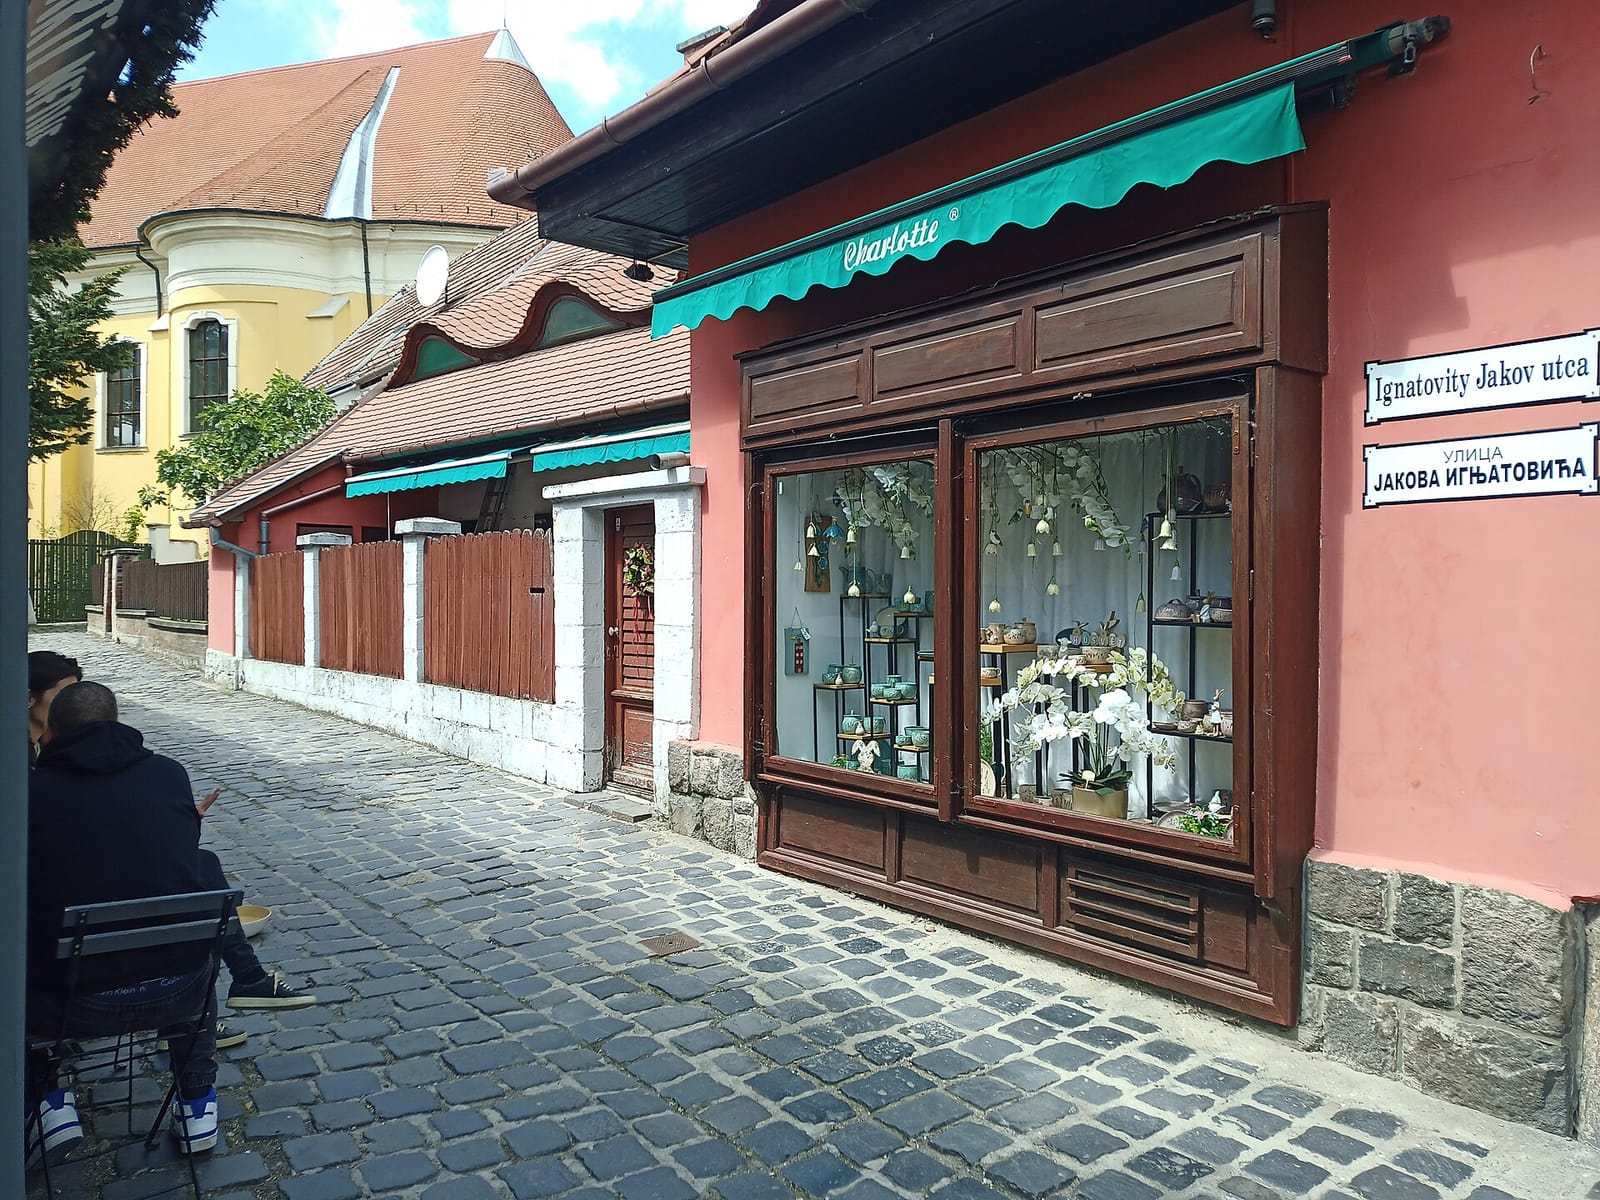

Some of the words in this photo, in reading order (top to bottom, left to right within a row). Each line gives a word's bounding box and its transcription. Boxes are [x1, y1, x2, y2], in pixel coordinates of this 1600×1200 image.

[844, 218, 938, 271] Charlotte
[1375, 368, 1470, 406] Ignatovity
[1477, 361, 1535, 389] Jakov
[1541, 355, 1589, 381] utca
[1374, 470, 1440, 491] ЈАКОВА
[1446, 457, 1586, 487] ИГЊАТОВИЋА
[1443, 446, 1503, 464] УЛИЦА
